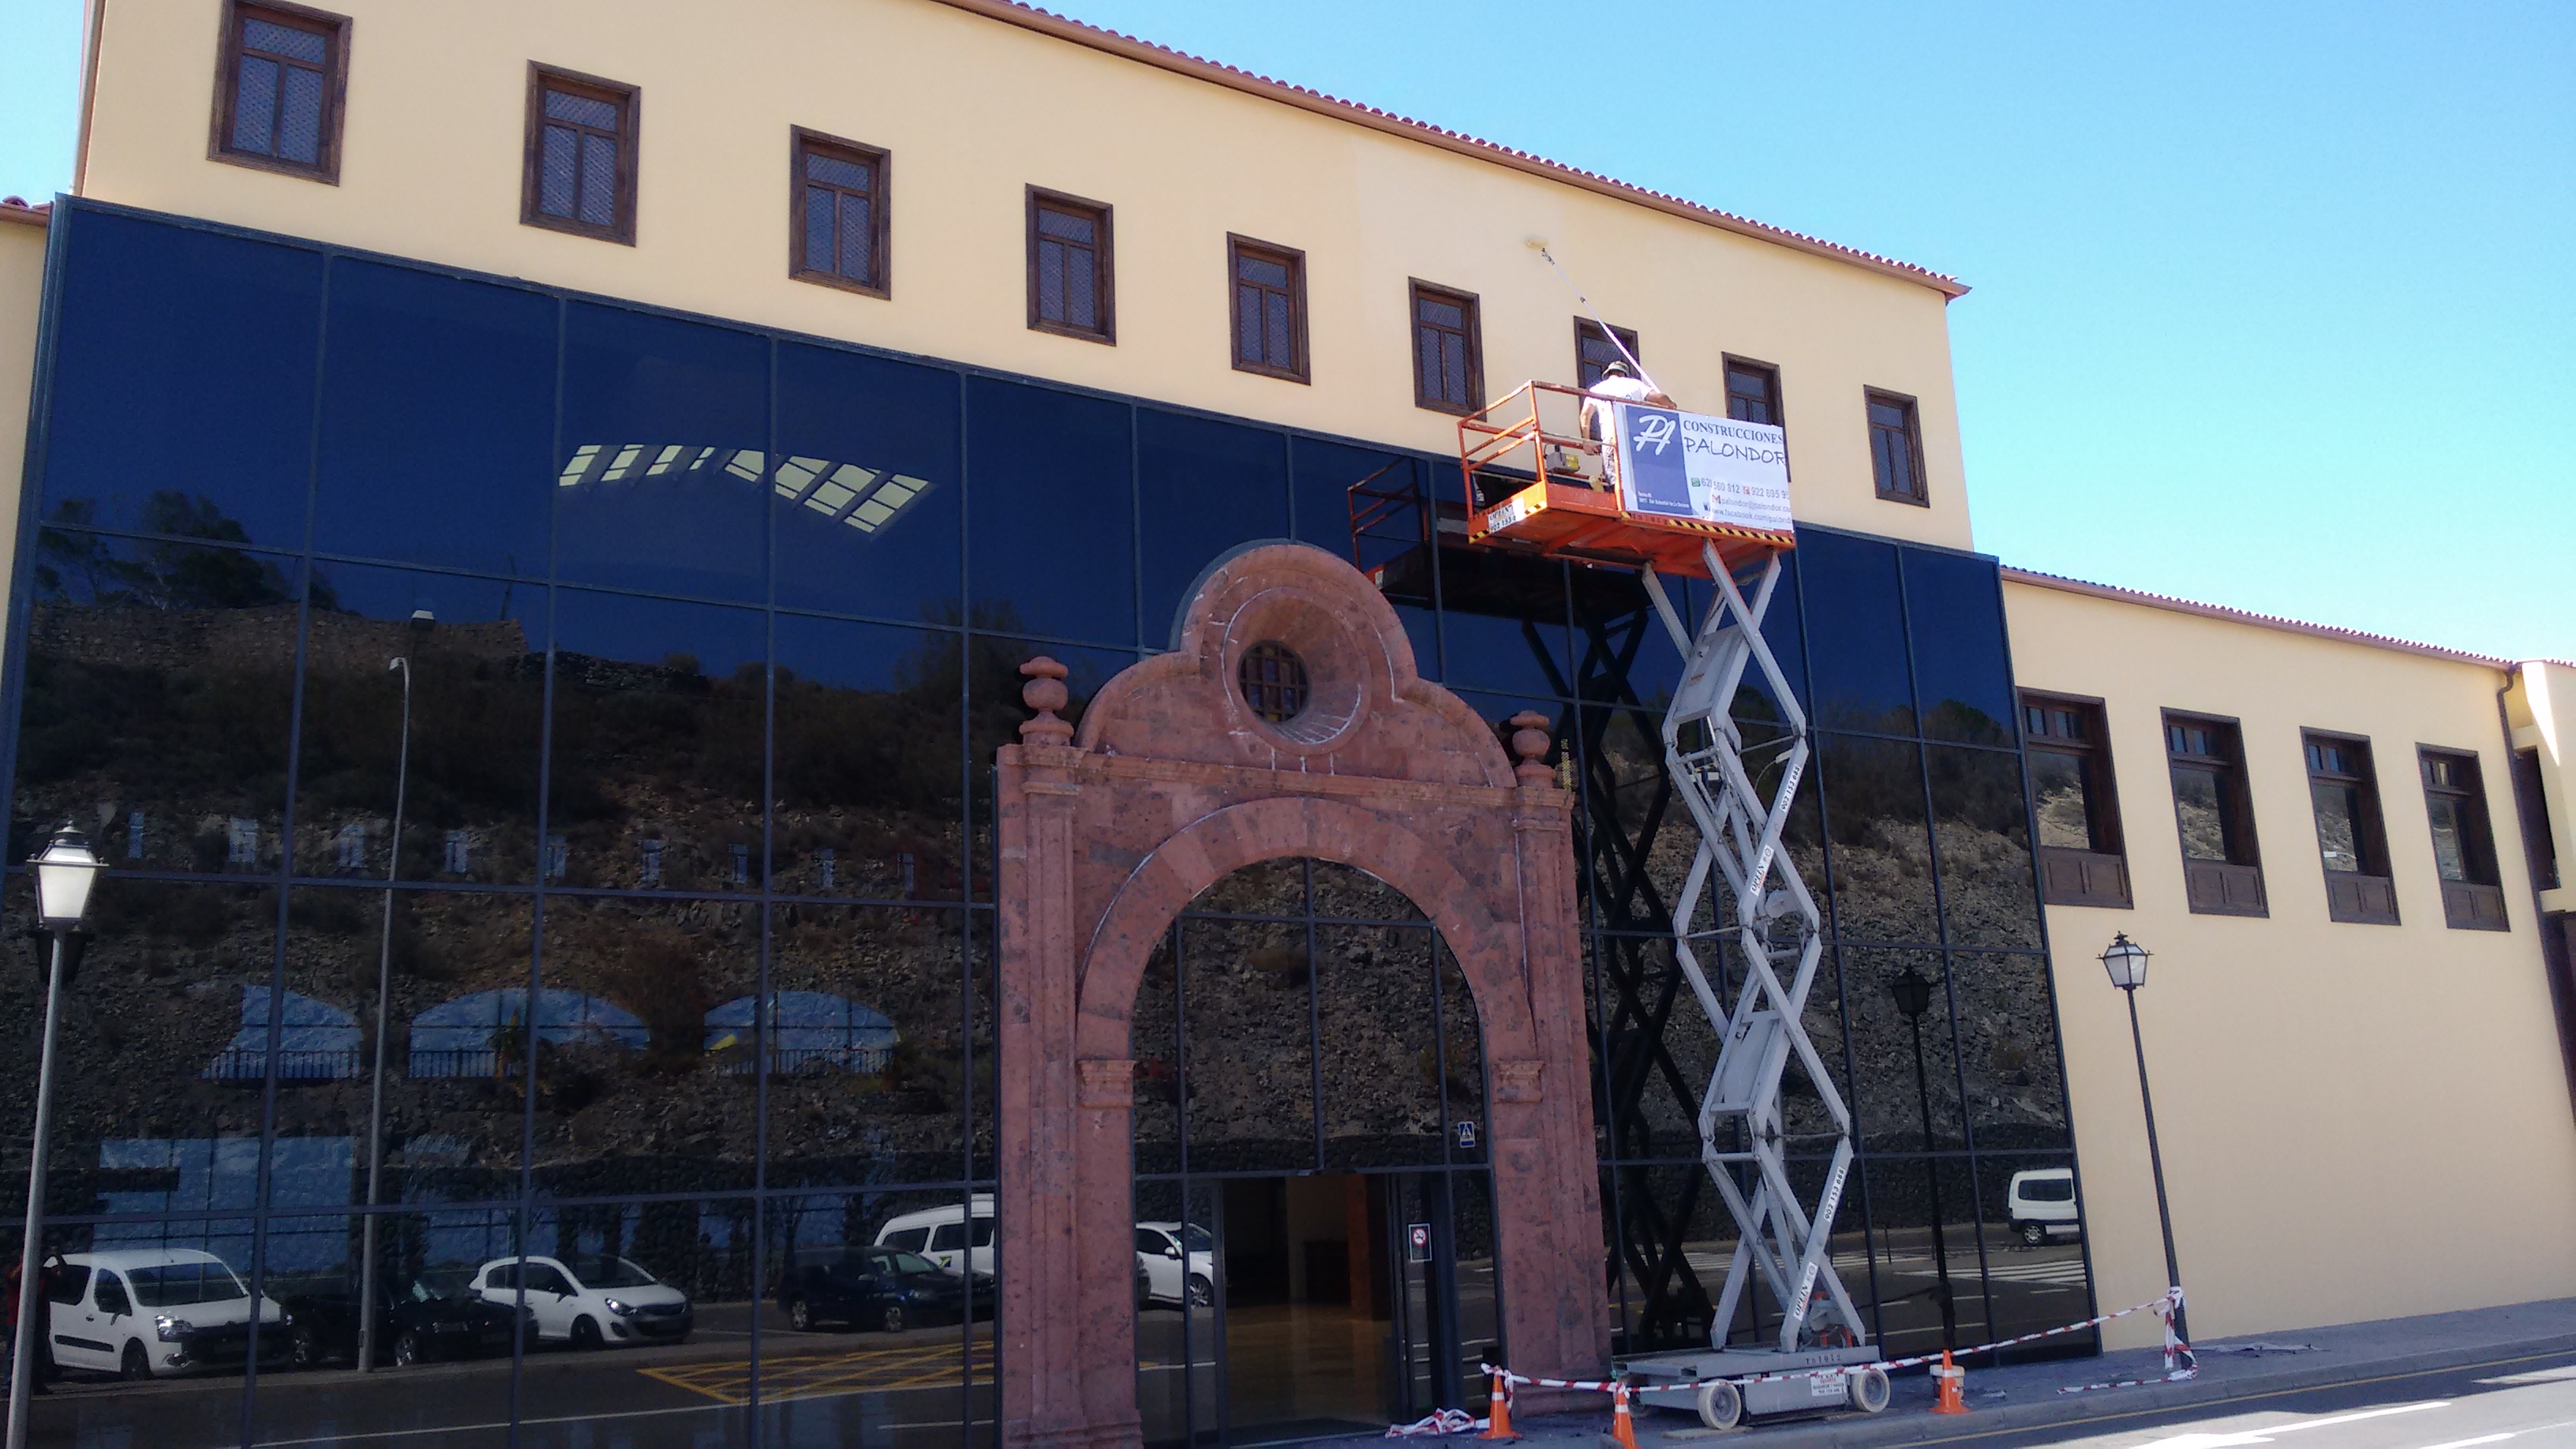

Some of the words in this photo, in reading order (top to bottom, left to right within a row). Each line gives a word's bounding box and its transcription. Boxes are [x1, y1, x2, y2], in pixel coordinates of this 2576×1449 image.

[1683, 420, 1783, 444] CONSTRUCCIONES
[1683, 436, 1785, 465] PALONDOR
[1727, 483, 1739, 493] 812
[1751, 486, 1764, 496] 922
[1780, 795, 1790, 811] 902
[1787, 781, 1795, 795] 153
[1825, 1204, 1834, 1219] 902
[1830, 1186, 1839, 1201] 153
